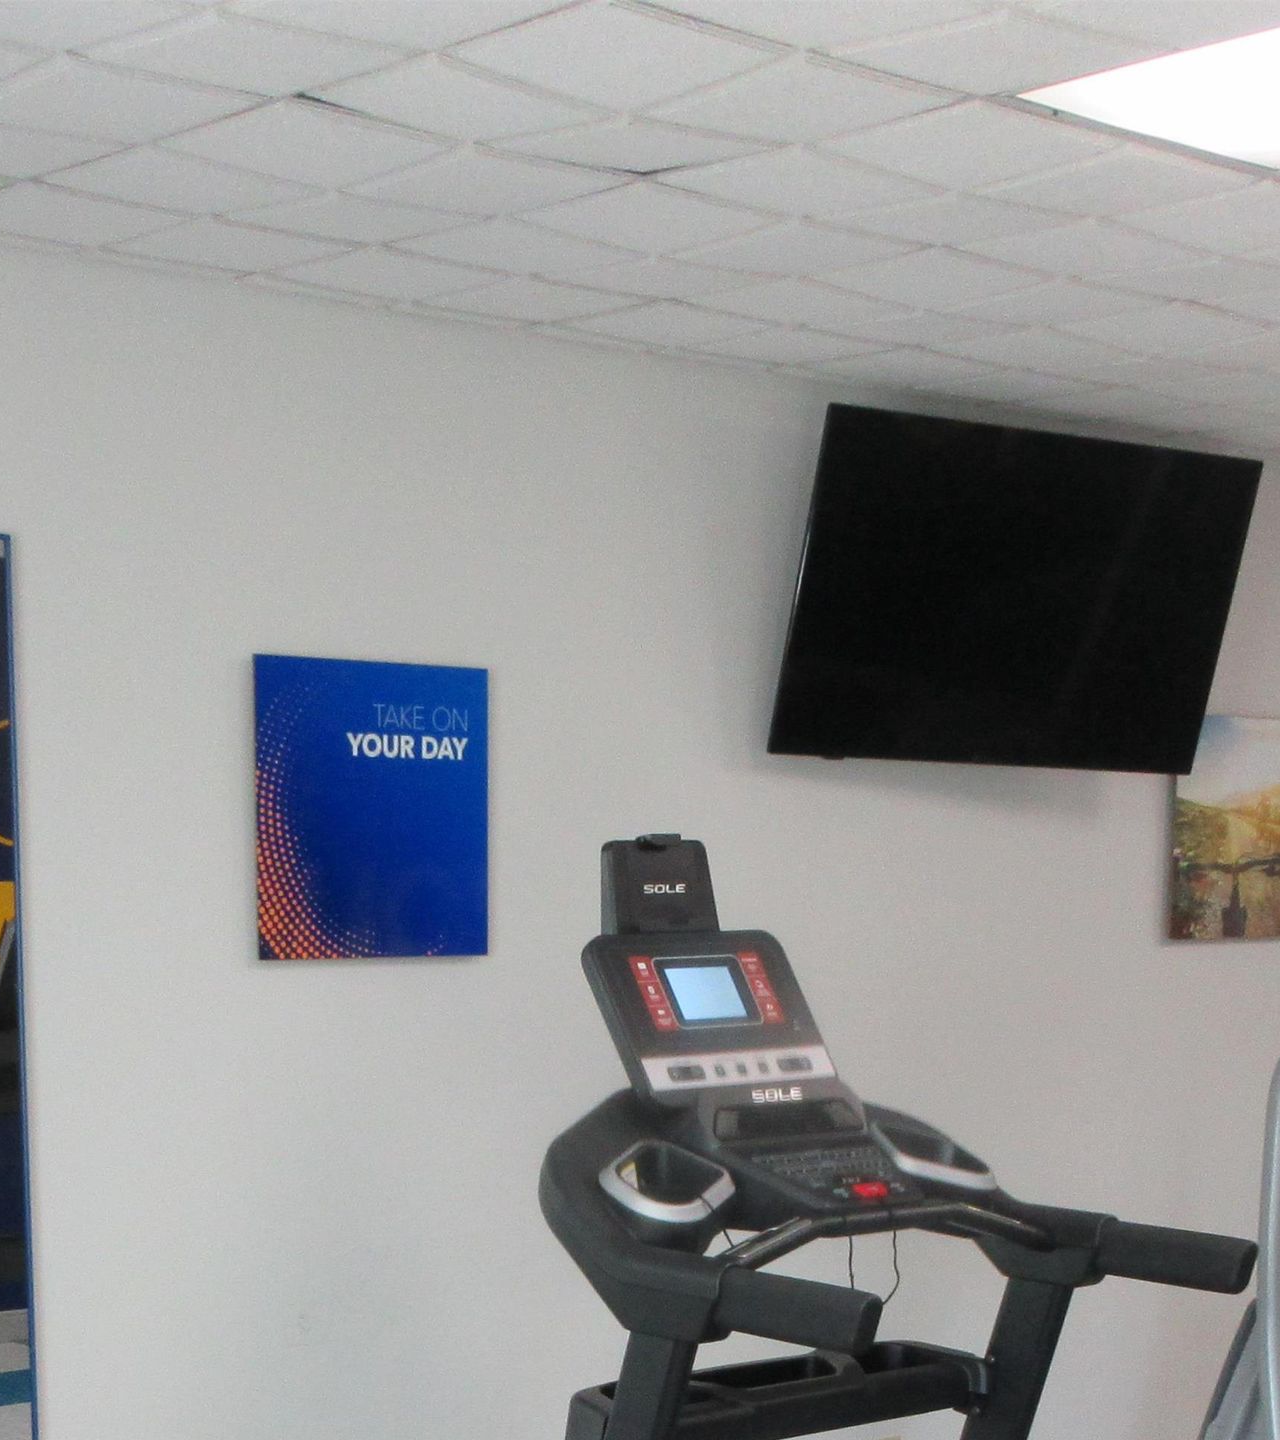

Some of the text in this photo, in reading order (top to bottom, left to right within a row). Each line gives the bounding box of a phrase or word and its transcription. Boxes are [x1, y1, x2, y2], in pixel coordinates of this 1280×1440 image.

[373, 703, 469, 732] TAKE ON
[346, 732, 468, 760] YOUR DAY
[643, 883, 687, 895] SOLE
[751, 1086, 803, 1104] SOLE
